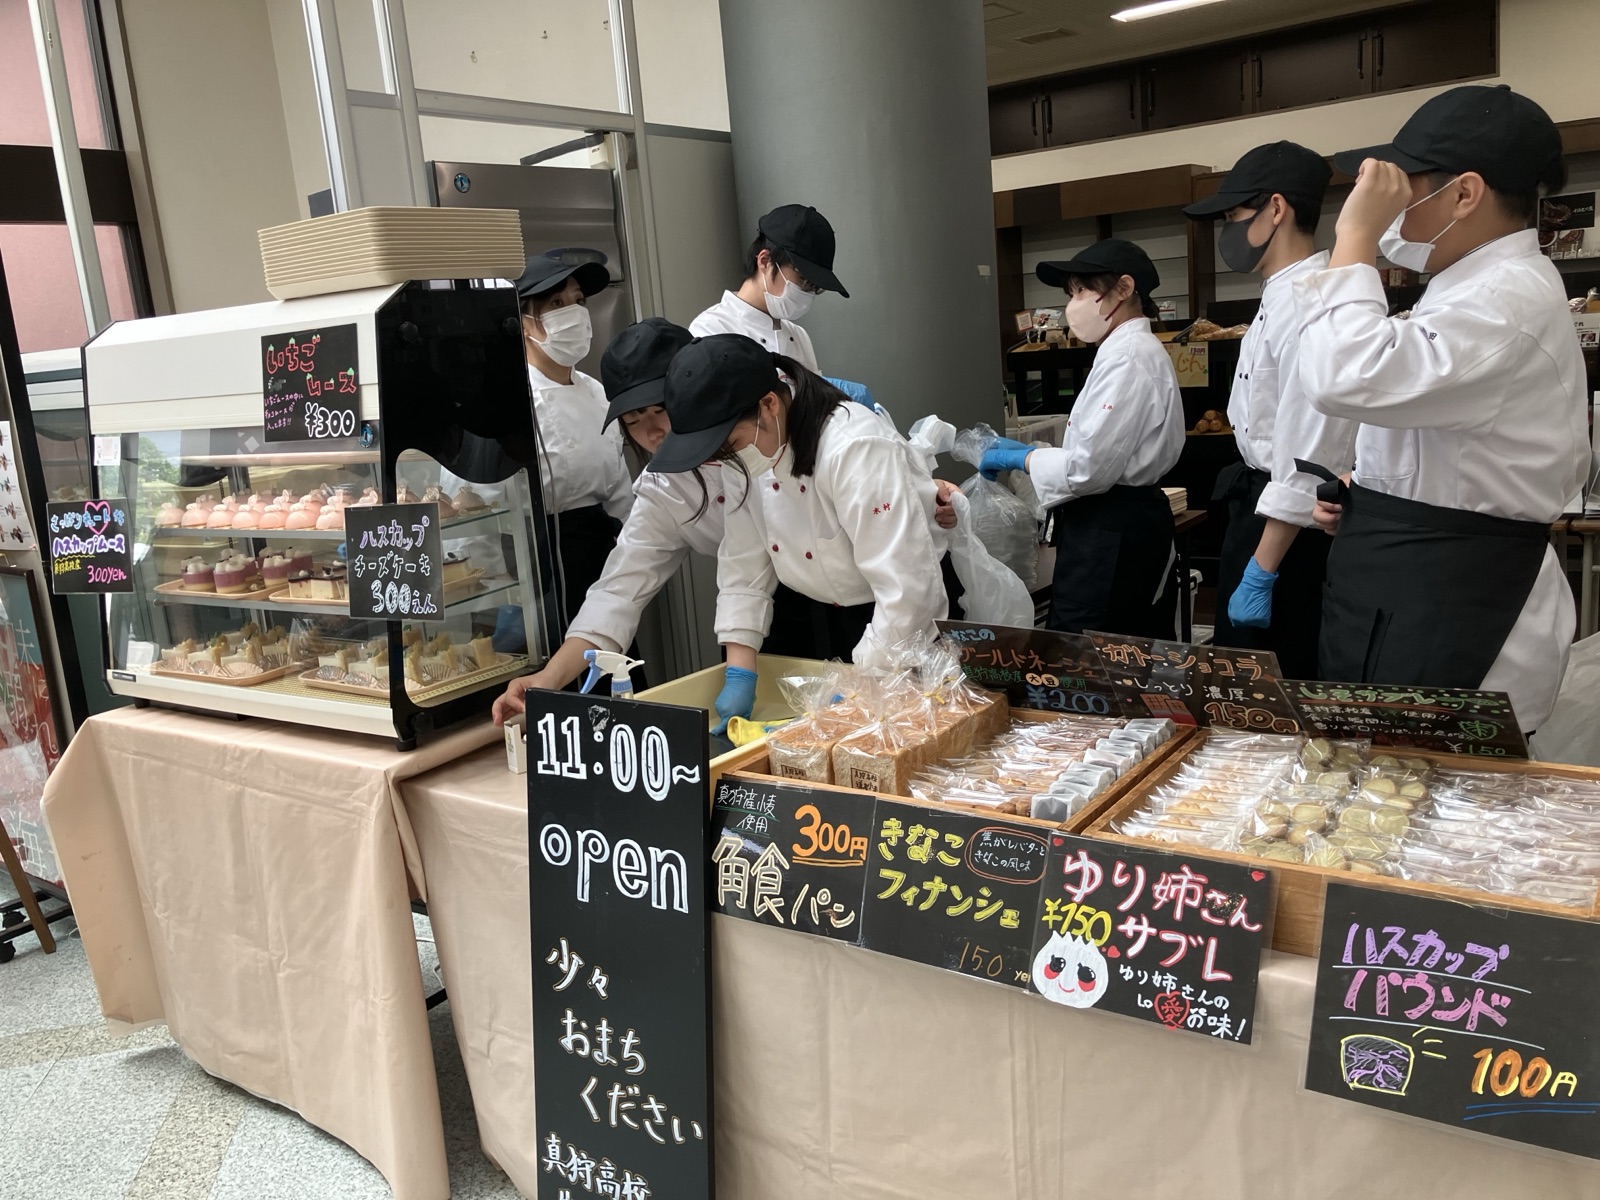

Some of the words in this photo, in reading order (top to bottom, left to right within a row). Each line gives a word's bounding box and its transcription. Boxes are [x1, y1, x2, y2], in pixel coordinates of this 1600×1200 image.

[266, 333, 321, 375] いちご
[305, 367, 357, 397] ムース
[304, 401, 356, 439] ¥300
[52, 533, 126, 558] ハスカップムース
[359, 515, 430, 552] ハスカップ
[354, 550, 431, 579] チーズケーキ
[370, 579, 438, 615] 300えん
[1102, 643, 1262, 681] ガトーショコラ
[1023, 684, 1111, 715] ¥200
[1133, 676, 1193, 697] しっとり
[1204, 684, 1250, 701] 濃厚
[1204, 701, 1299, 734] 150円
[1444, 740, 1506, 755] ¥150
[735, 813, 768, 834] 使用
[791, 804, 869, 861] 300円
[877, 817, 965, 867] きなこ
[539, 823, 689, 914] open
[974, 849, 1033, 872] きなこの風味
[876, 868, 1021, 929] フィナンシェ
[1062, 849, 1263, 932] ゆり姉さん
[1041, 897, 1113, 947] ¥150
[545, 937, 609, 1000] 少々
[959, 941, 1003, 977] 150
[1341, 922, 1510, 982] ハスカップ
[1118, 963, 1230, 1010] ゆり姉さんの
[1343, 969, 1512, 1032] パウンド
[558, 1007, 647, 1076] おまち
[1470, 1047, 1578, 1098] 100円
[579, 1075, 704, 1145] ください
[542, 1131, 651, 1200] 真狩高校
